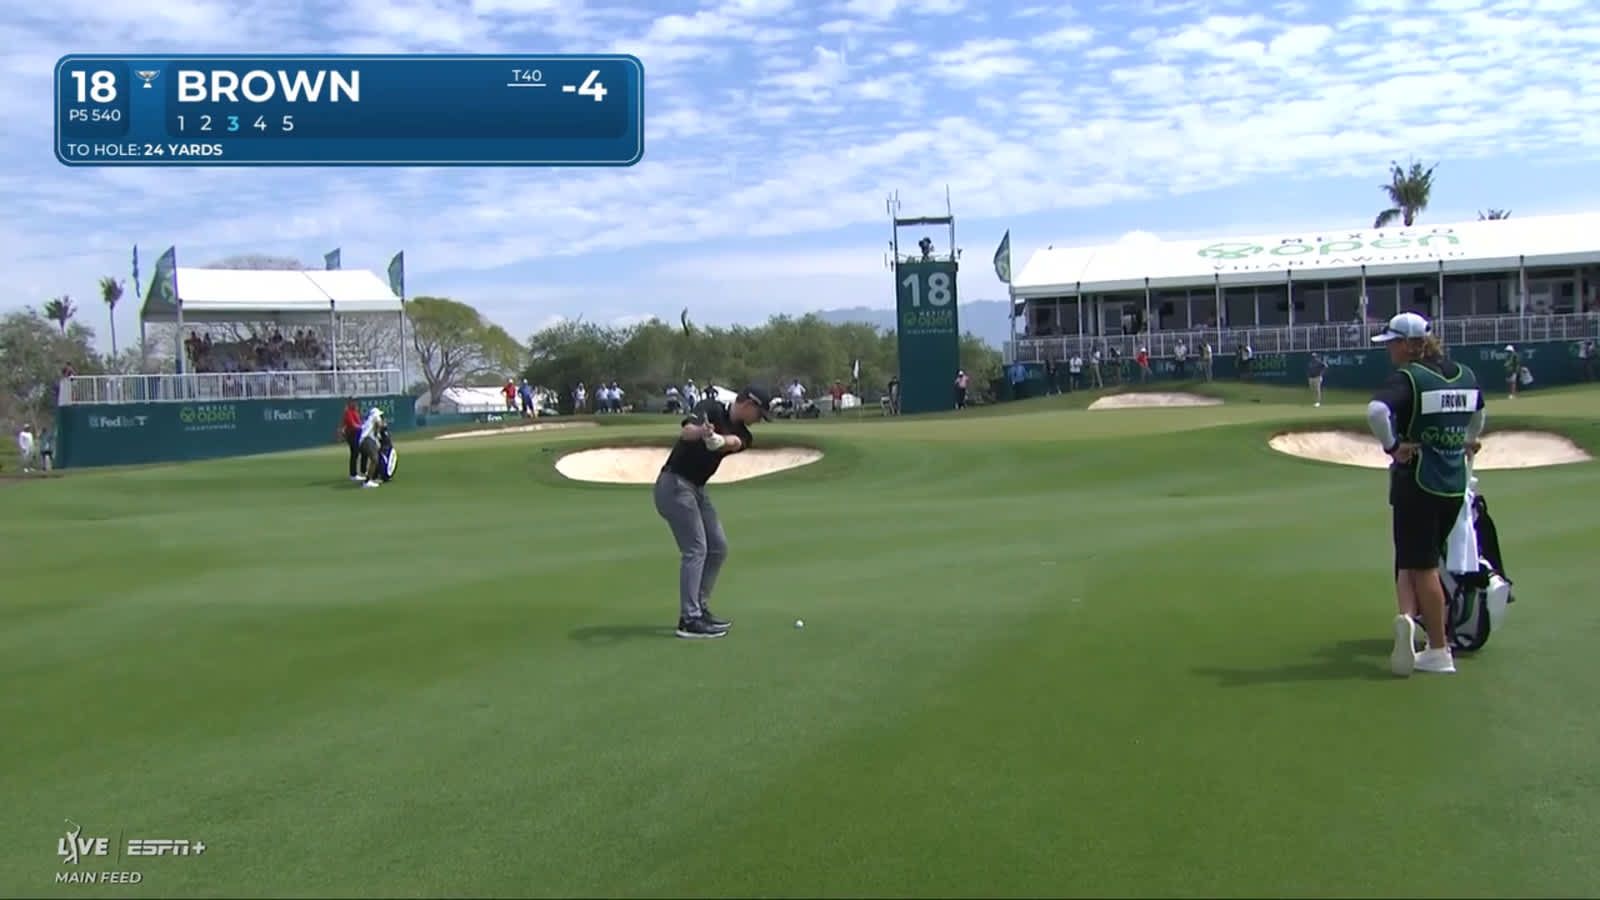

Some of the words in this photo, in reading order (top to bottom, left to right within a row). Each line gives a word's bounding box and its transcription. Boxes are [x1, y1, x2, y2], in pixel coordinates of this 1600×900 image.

[1269, 234, 1460, 256] open
[902, 271, 952, 307] 18
[1441, 394, 1467, 408] BROWN
[197, 411, 237, 424] open
